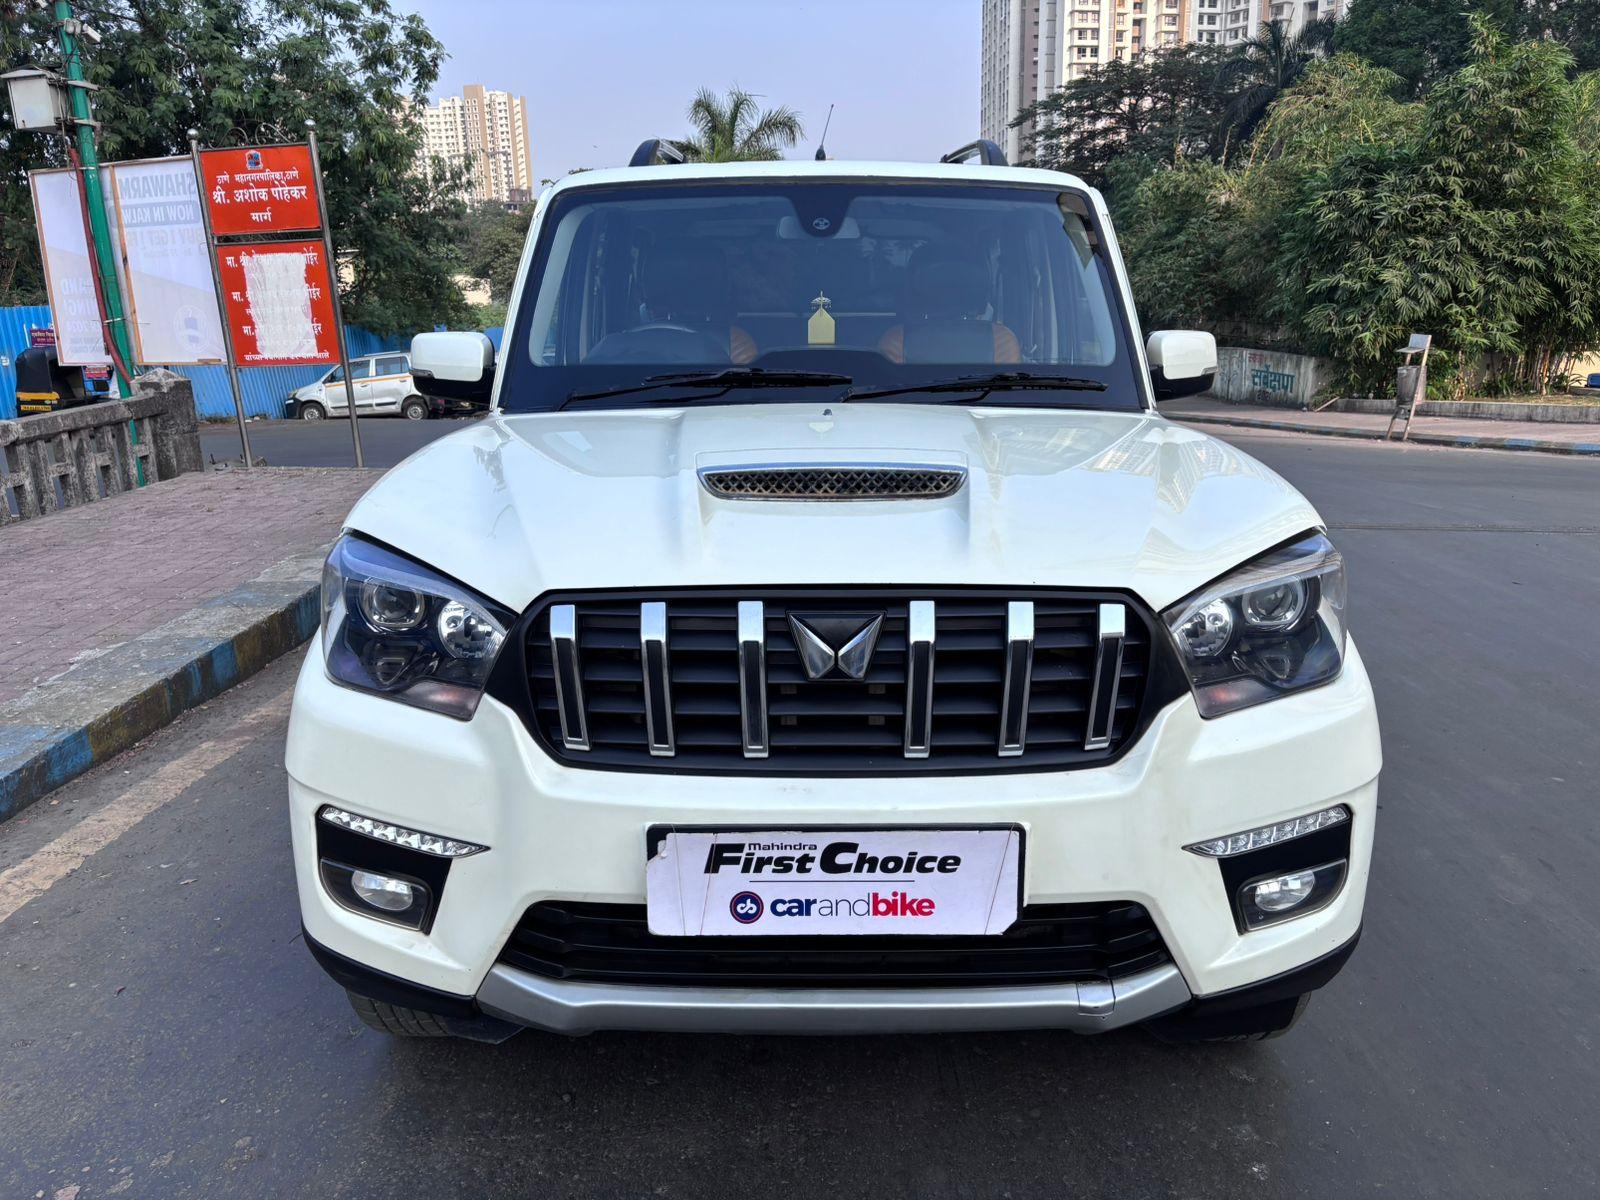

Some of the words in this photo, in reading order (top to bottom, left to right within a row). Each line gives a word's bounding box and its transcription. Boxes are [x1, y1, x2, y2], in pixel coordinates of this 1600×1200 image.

[216, 171, 230, 185] ठाणे
[212, 185, 231, 205] श्री.
[233, 183, 269, 203] अशोक
[271, 180, 308, 203] पोहेकर
[250, 207, 272, 222] मार्ग
[749, 842, 817, 851] Mahindra
[703, 842, 816, 874] First
[819, 841, 962, 874] Choice
[769, 890, 936, 917] carandbike
